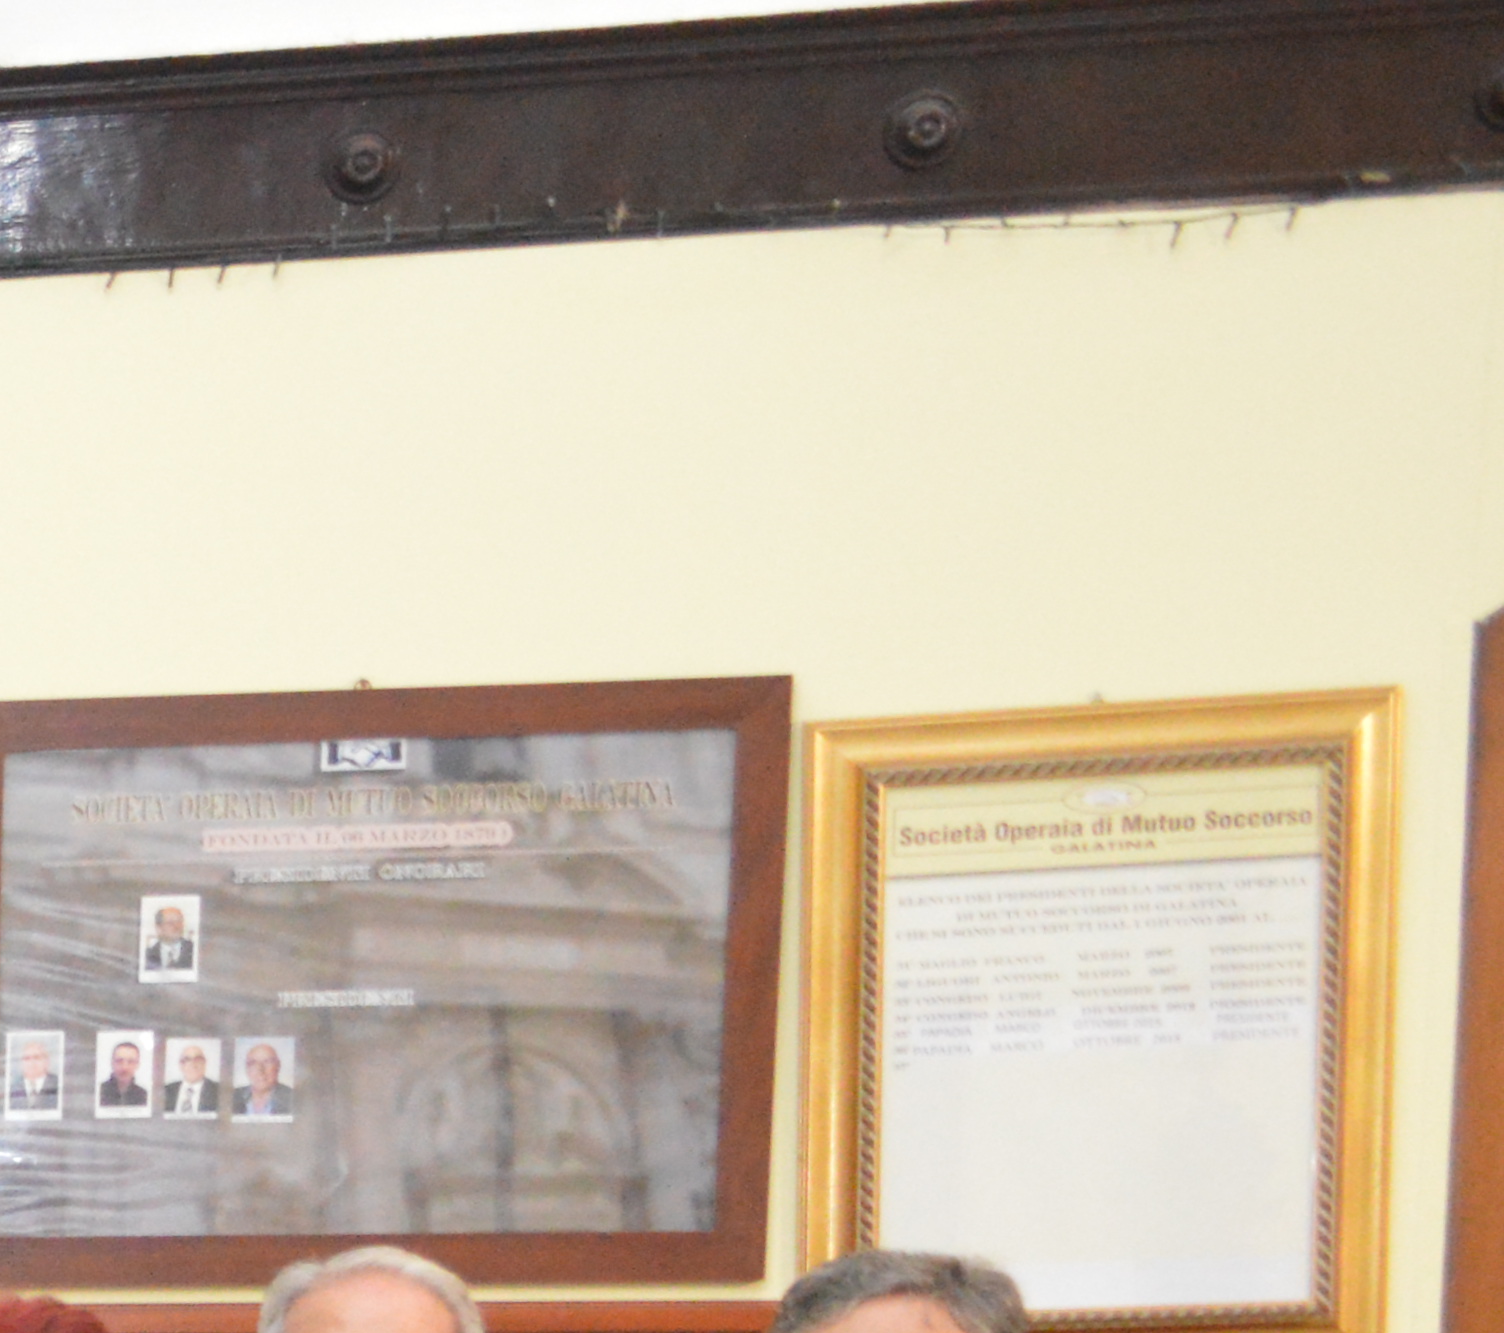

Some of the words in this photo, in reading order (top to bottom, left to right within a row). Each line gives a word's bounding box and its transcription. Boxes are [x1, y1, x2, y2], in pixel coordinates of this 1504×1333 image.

[899, 822, 987, 848] Società
[994, 818, 1084, 846] Operaia
[1092, 814, 1113, 838] di
[1121, 813, 1196, 835] Mutuo
[1203, 807, 1313, 831] Soccorso
[1049, 838, 1159, 855] GALATINA
